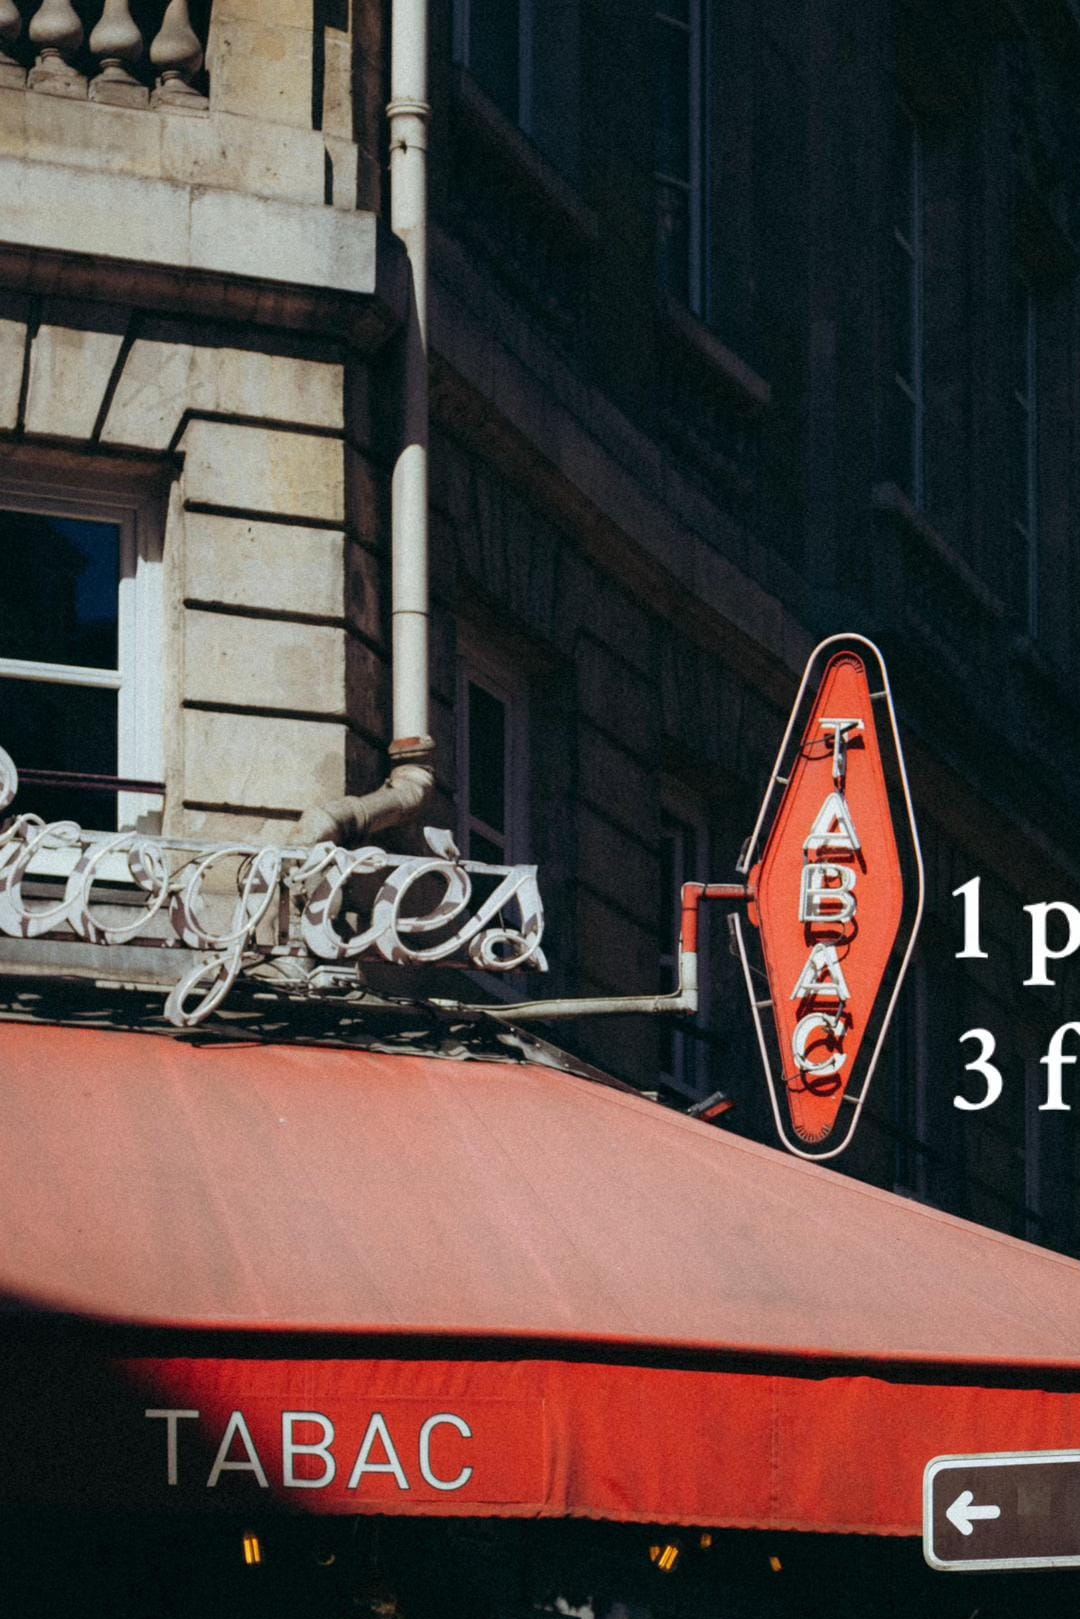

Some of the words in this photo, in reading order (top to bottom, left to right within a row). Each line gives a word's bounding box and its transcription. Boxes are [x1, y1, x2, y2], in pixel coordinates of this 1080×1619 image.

[0, 745, 550, 1028] rogrès
[790, 717, 864, 1076] TABAC
[144, 1408, 473, 1491] TABAC
